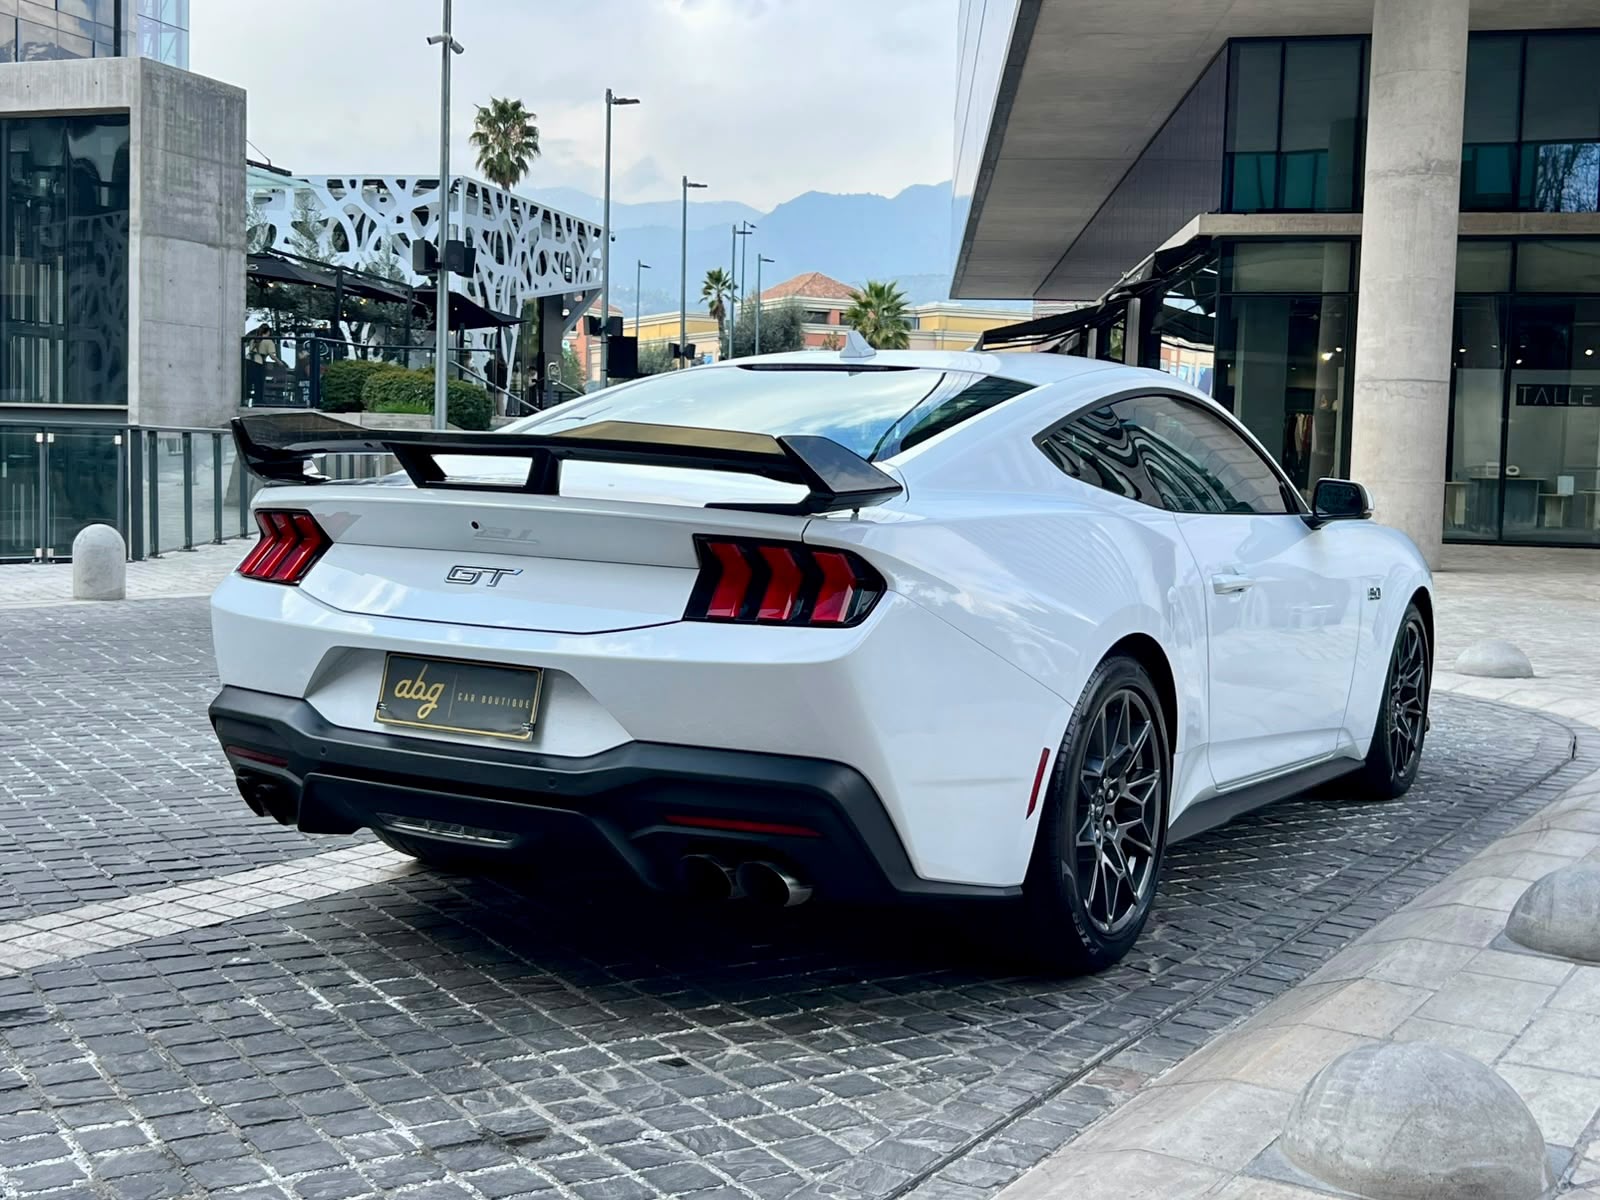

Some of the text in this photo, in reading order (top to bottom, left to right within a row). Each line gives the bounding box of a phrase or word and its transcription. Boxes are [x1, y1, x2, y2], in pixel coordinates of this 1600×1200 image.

[444, 565, 523, 587] GT
[394, 664, 445, 719] abg
[457, 691, 531, 709] CAR BOUTIQUE
